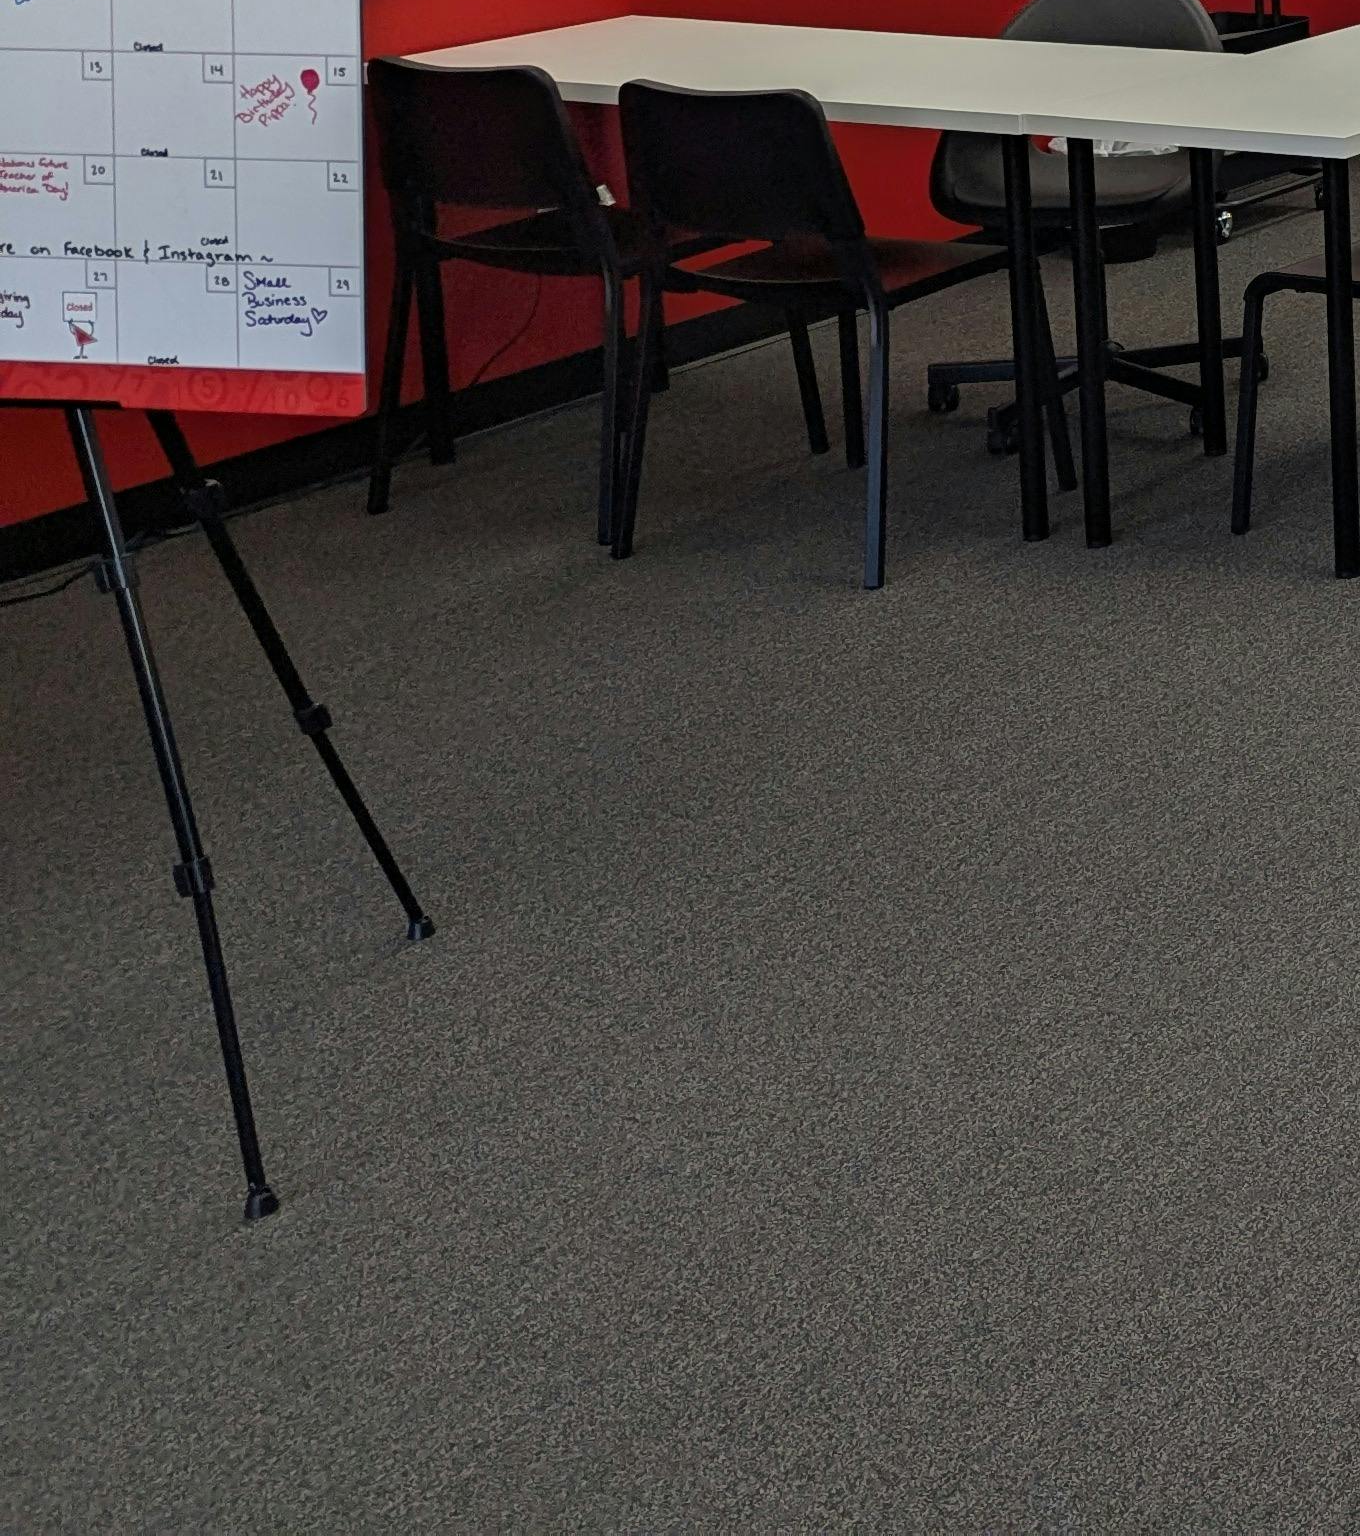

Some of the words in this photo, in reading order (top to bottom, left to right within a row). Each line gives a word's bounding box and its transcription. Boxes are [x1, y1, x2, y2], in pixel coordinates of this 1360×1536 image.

[90, 61, 102, 73] 13
[210, 65, 224, 76] 14
[334, 67, 346, 77] 15
[240, 74, 283, 99] Happy
[42, 172, 54, 181] of
[91, 164, 105, 176] 20
[210, 169, 223, 182] 21
[333, 172, 349, 183] 22
[30, 246, 50, 255] on
[64, 241, 134, 259] Facebook
[158, 245, 253, 267] Instagram
[93, 272, 108, 281] 27
[214, 275, 230, 286] 28
[336, 279, 350, 290] 29
[66, 302, 93, 312] Closed
[242, 291, 307, 309] Business
[244, 310, 313, 337] Saturday
[147, 355, 179, 365] Closed
